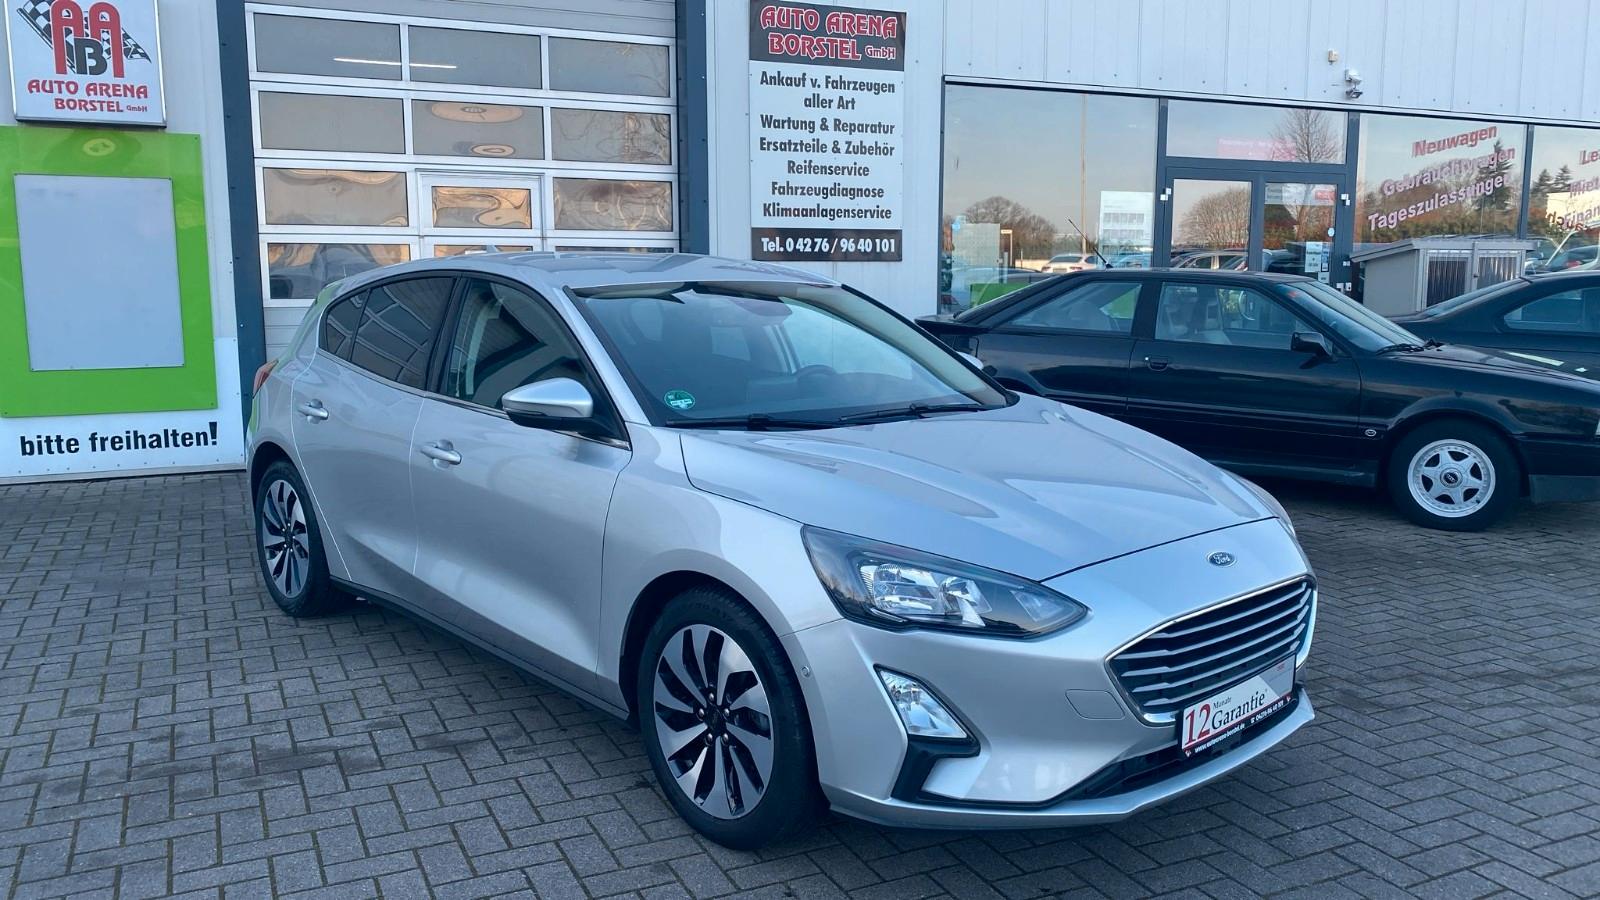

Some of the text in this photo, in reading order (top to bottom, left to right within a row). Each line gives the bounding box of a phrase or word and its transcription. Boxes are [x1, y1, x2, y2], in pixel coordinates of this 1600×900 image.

[760, 6, 897, 39] AUTO ARENA
[768, 32, 896, 61] BORSTEL GmbH
[27, 79, 148, 99] AUTO ARENA
[760, 71, 896, 95] Ankauf v. Fahrzeugen
[54, 98, 148, 113] BORSTEL GmbH
[803, 93, 856, 110] aller Art
[760, 114, 896, 136] Wartung & Reparatur
[759, 137, 895, 156] Ersatzteile & Zubehör
[1412, 126, 1498, 157] Neuwagen
[787, 160, 870, 177] Reifenservice
[771, 181, 885, 201] Fahrzeugdiagnose
[762, 203, 892, 221] Klimaanlagenservice
[761, 237, 784, 252] Tel.
[20, 421, 218, 456] bitte freihalten!
[1185, 691, 1265, 745] 12 Garantie
